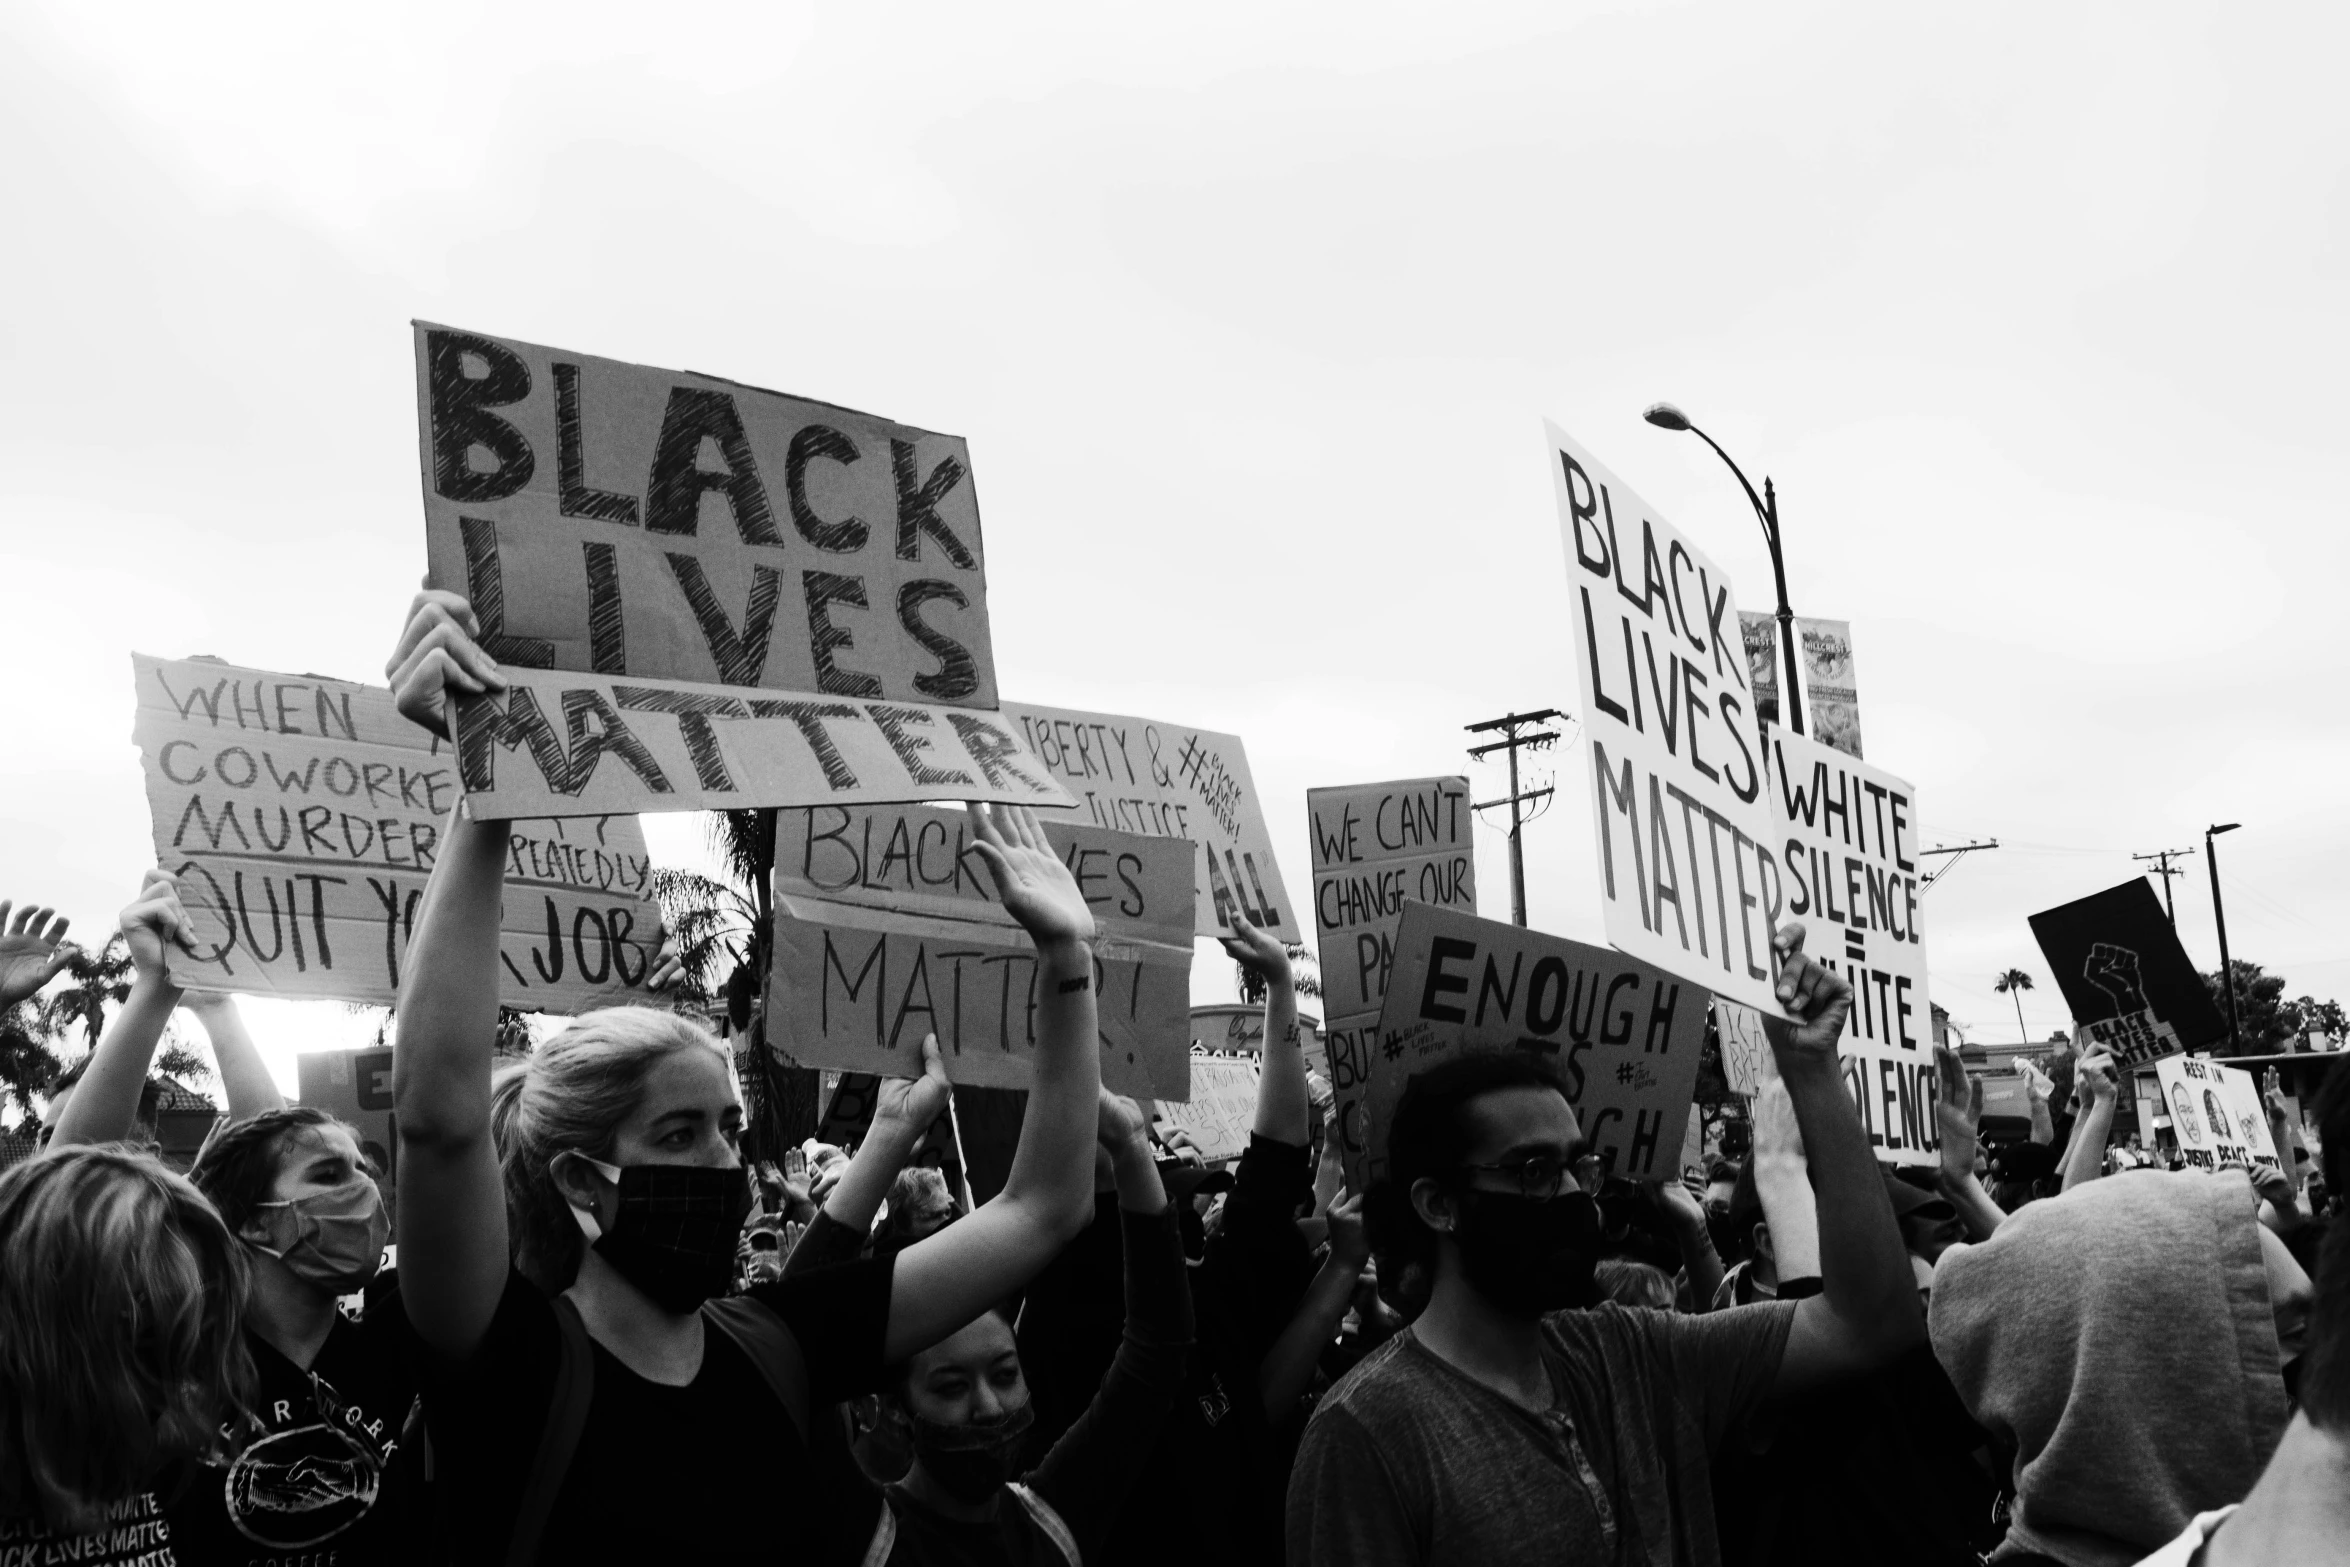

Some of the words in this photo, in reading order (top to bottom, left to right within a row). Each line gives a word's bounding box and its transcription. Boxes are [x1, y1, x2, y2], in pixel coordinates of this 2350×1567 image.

[426, 329, 978, 572] BLACK
[459, 515, 980, 700] LIVES
[1559, 448, 1746, 691] BLACK
[1744, 635, 1769, 646] CREST
[156, 667, 358, 741] WHEN
[1579, 585, 1758, 803] LIVES
[159, 739, 455, 815] COWORKE
[456, 685, 1062, 797] MATTER
[1020, 715, 1136, 787] IBERTY
[1145, 725, 1175, 790] &
[1199, 781, 1241, 845] MATTER!
[1315, 802, 1364, 866] WE
[1376, 782, 1464, 851] CAN'T
[1774, 739, 1914, 873] WHITE
[505, 833, 655, 903] PEATEDLY,
[802, 804, 989, 901] BLACK
[1593, 740, 1784, 984] MATTER
[174, 860, 347, 976] QUIT
[1319, 869, 1407, 929] CHANGE
[1419, 857, 1472, 906] OUR
[1784, 837, 1920, 945] SILENCE
[531, 895, 648, 988] JOB
[1403, 1020, 1429, 1041] BLACK
[1418, 935, 1680, 1055] ENOUGH
[1820, 956, 1917, 1052] ITE
[2090, 1011, 2150, 1043] BLACK
[1331, 1026, 1378, 1090] BUT
[1411, 1031, 1436, 1049] LIVES
[2110, 1026, 2157, 1052] IVES
[2112, 1035, 2174, 1069] ATTER
[2183, 1061, 2208, 1080] REST
[2210, 1066, 2225, 1085] IN
[1850, 1057, 1941, 1154] LENCE
[46, 1531, 107, 1566] LIVES
[110, 1517, 171, 1555] MATTE
[104, 1491, 164, 1524] MATTE
